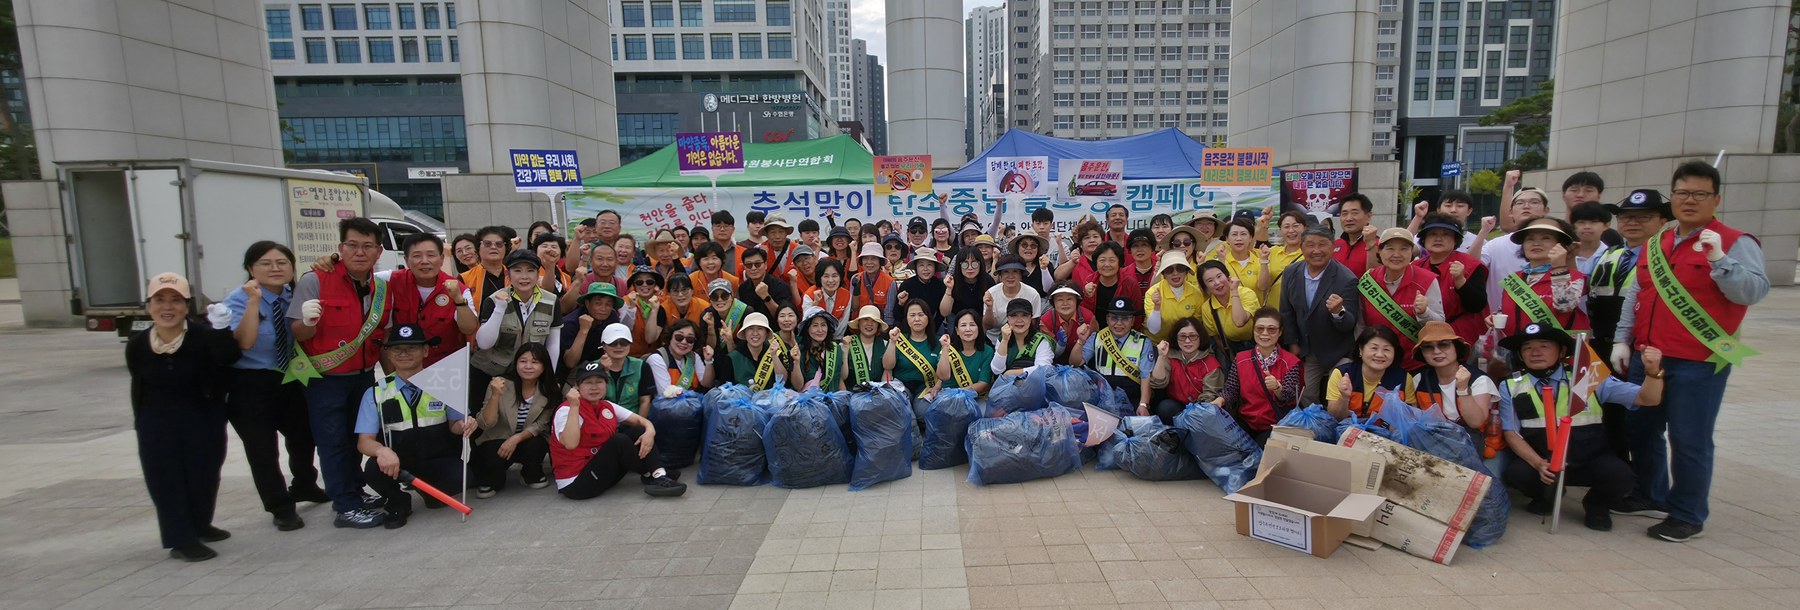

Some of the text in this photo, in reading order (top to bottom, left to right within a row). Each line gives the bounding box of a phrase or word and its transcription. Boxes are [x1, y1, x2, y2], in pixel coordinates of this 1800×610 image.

[720, 94, 759, 103] 메디그린
[762, 93, 801, 104] 한방병원
[764, 128, 795, 142] CGV
[678, 133, 740, 152] 마약중독, 아름다운
[514, 153, 577, 168] 마약 없는 우리 사회,
[686, 151, 739, 167] 기억은 없습니다.
[991, 160, 1002, 171] 담배
[1205, 152, 1269, 166] 음주운전 불행시작
[517, 169, 578, 183] 건강 가득 행복 가득
[1204, 168, 1268, 183] 대리운전 행복시작
[1300, 171, 1314, 180] 오늘
[1315, 171, 1329, 180] 끊지
[1330, 170, 1352, 179] 않으면
[1315, 180, 1345, 189] 없습니다.
[308, 186, 357, 202] 열린종합상사
[751, 189, 872, 218] 추석맞이
[1126, 184, 1214, 211] 캠페인
[639, 192, 708, 228] 천안을 줍다
